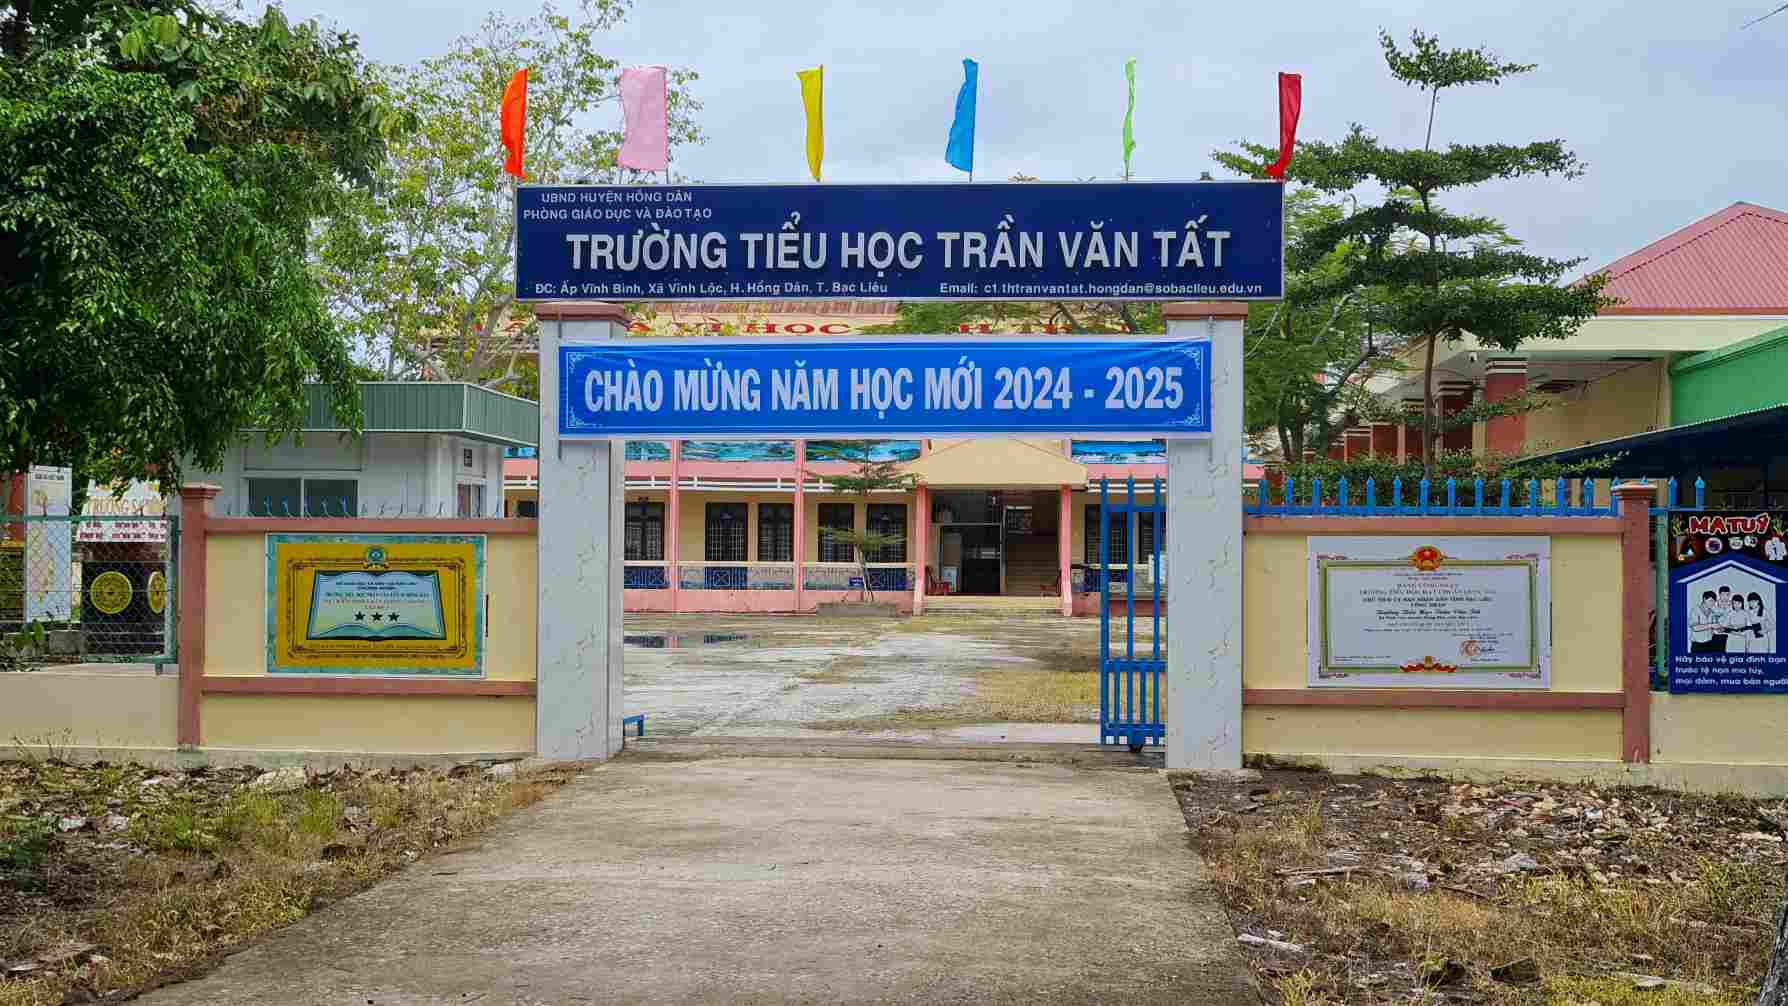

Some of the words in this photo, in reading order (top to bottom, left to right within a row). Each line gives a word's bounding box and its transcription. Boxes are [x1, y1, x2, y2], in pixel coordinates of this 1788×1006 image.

[541, 192, 576, 203] UBND
[580, 191, 623, 204] HUYỆN
[666, 190, 692, 203] DÂN
[523, 207, 568, 220] PHÒNG
[571, 207, 602, 220] GIÁO
[605, 209, 632, 222] DỤC
[636, 207, 653, 219] VÀ
[656, 206, 683, 219] ĐÀO
[684, 208, 712, 222] TẠO
[566, 223, 727, 271] TRƯỜNG
[740, 212, 827, 270] TIỂU
[841, 232, 923, 277] HỌC
[937, 214, 1043, 268] TRẦN
[1058, 220, 1139, 268] VĂN
[1153, 214, 1231, 268] TẤT
[535, 283, 557, 294] ĐC:
[648, 282, 664, 294] Xã
[700, 281, 727, 296] Lộc,
[940, 282, 978, 294] Email:
[584, 358, 664, 413] CHÀO
[673, 357, 761, 413] MỪNG
[771, 359, 839, 411] NĂM
[851, 367, 913, 420] HỌC
[924, 355, 982, 411] MỚI
[993, 366, 1072, 410] 2024
[1104, 366, 1184, 410] 2025
[1729, 655, 1744, 664] gia
